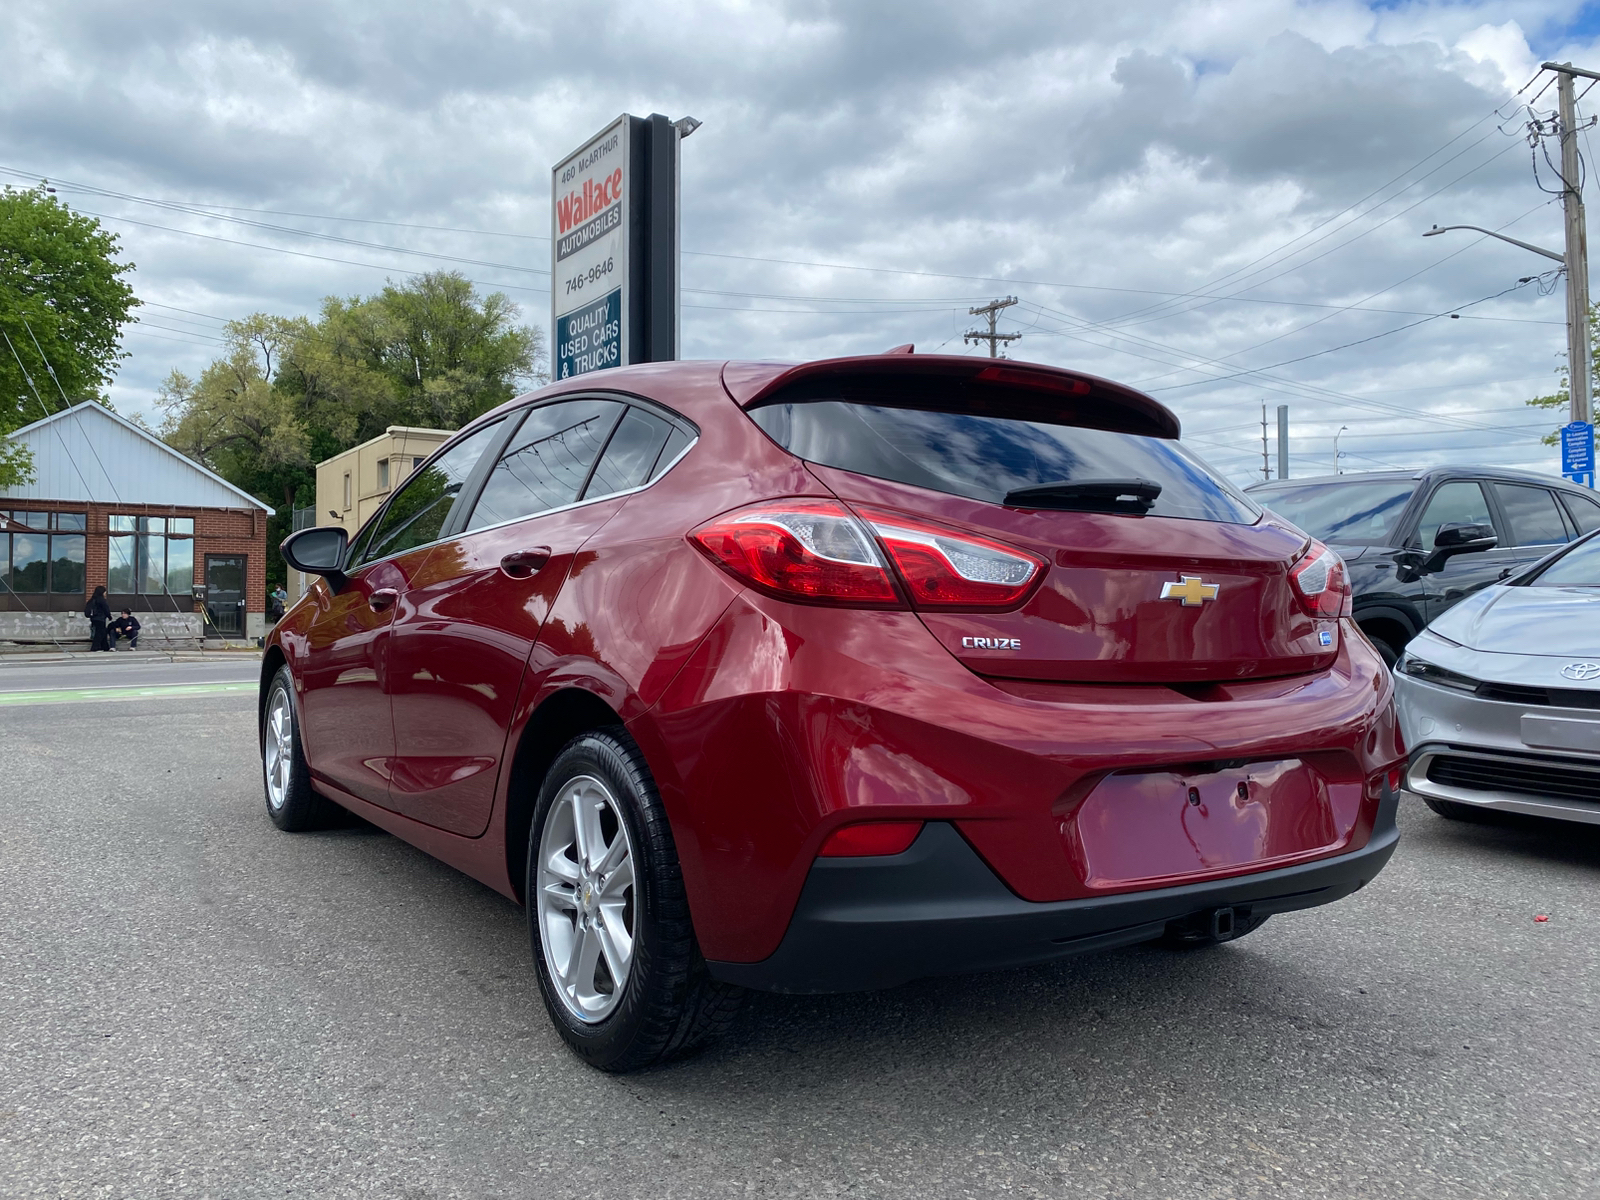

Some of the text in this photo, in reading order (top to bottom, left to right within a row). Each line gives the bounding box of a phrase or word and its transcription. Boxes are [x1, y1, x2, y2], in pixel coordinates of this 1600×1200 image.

[561, 134, 618, 184] 460 McARTHUR
[556, 167, 622, 234] Wallace
[560, 206, 619, 256] AUTOMOBILES
[565, 256, 614, 295] 746-9646
[560, 319, 619, 359] USED CARS
[569, 303, 610, 337] QUALITY
[561, 341, 618, 379] & TRUCKS
[962, 636, 1021, 650] CRUZE
